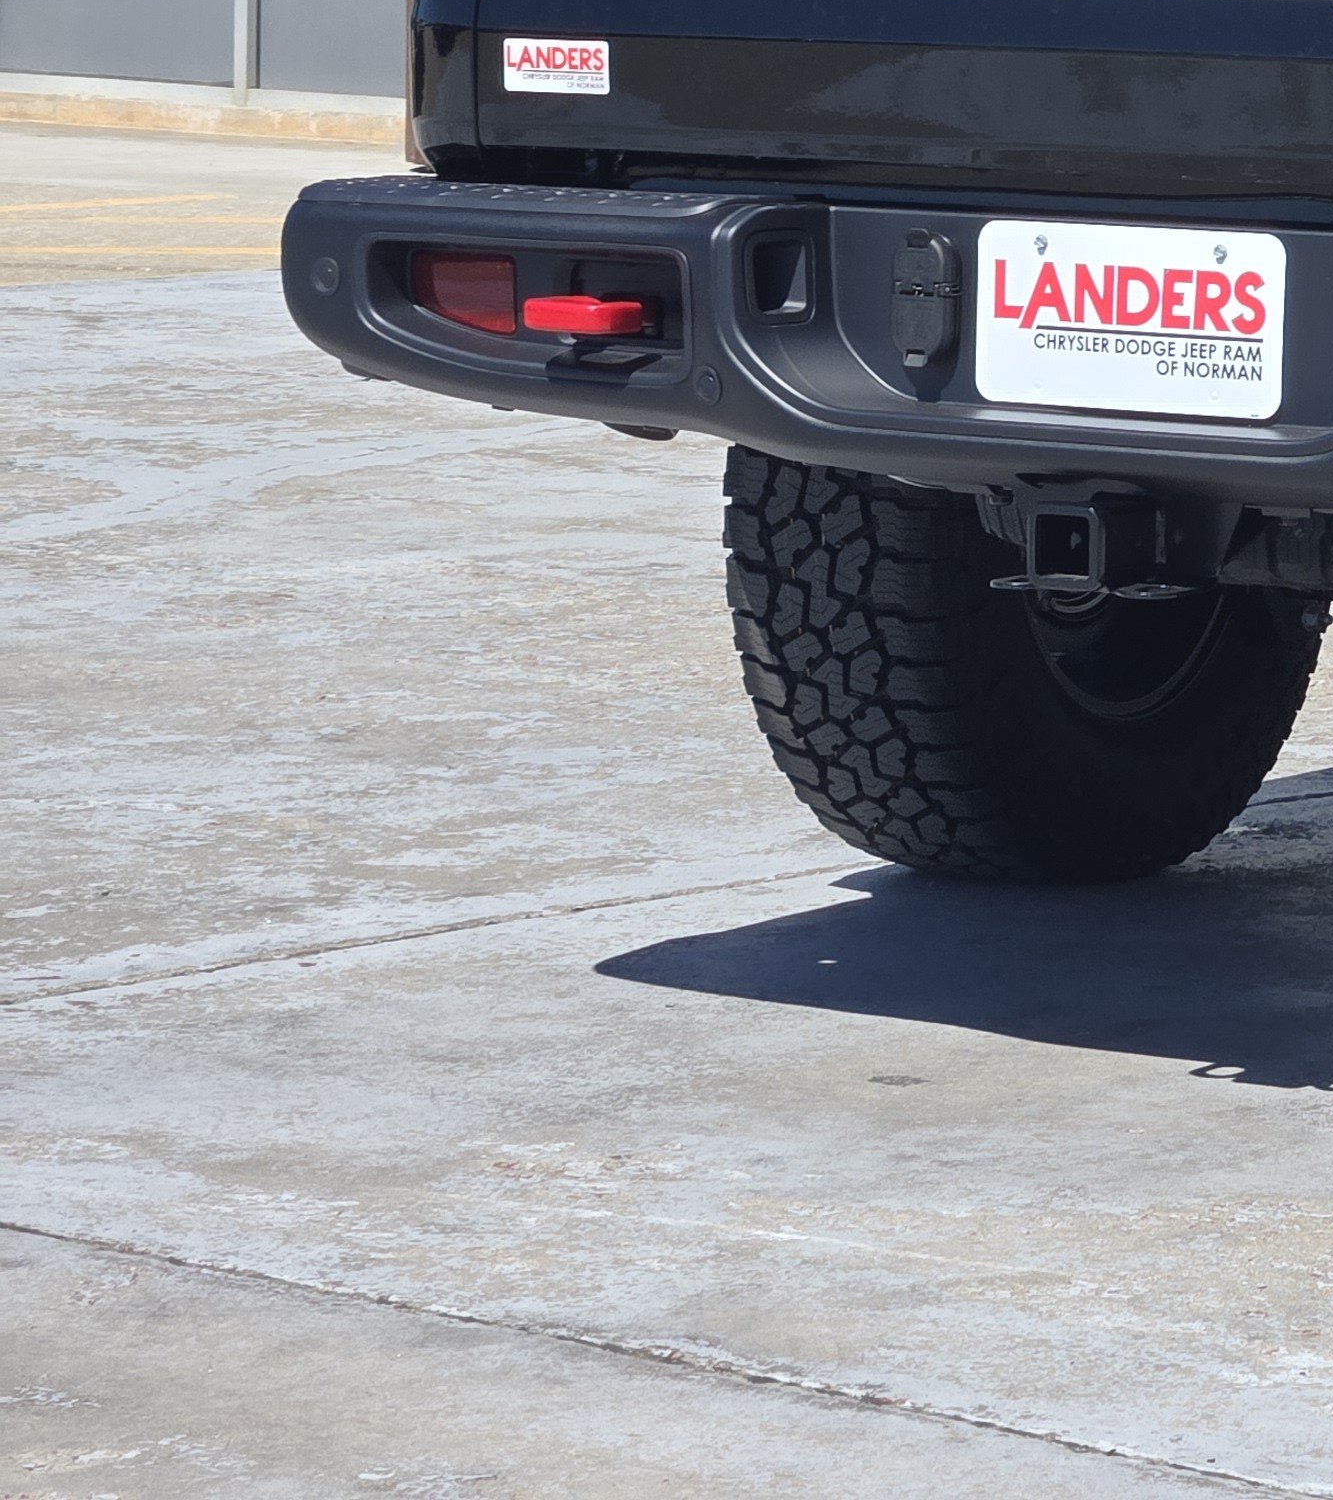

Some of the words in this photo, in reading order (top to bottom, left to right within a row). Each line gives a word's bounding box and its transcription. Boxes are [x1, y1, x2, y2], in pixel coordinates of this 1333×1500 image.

[507, 45, 604, 71] LANDERS
[994, 258, 1266, 335] LANDERS
[1034, 333, 1109, 353] CHRYSLER
[1115, 339, 1176, 357] DODGE
[1181, 343, 1217, 360] JEEP
[1223, 345, 1262, 363] RAM
[1156, 360, 1179, 376] OF
[1184, 363, 1262, 381] NORMAN
